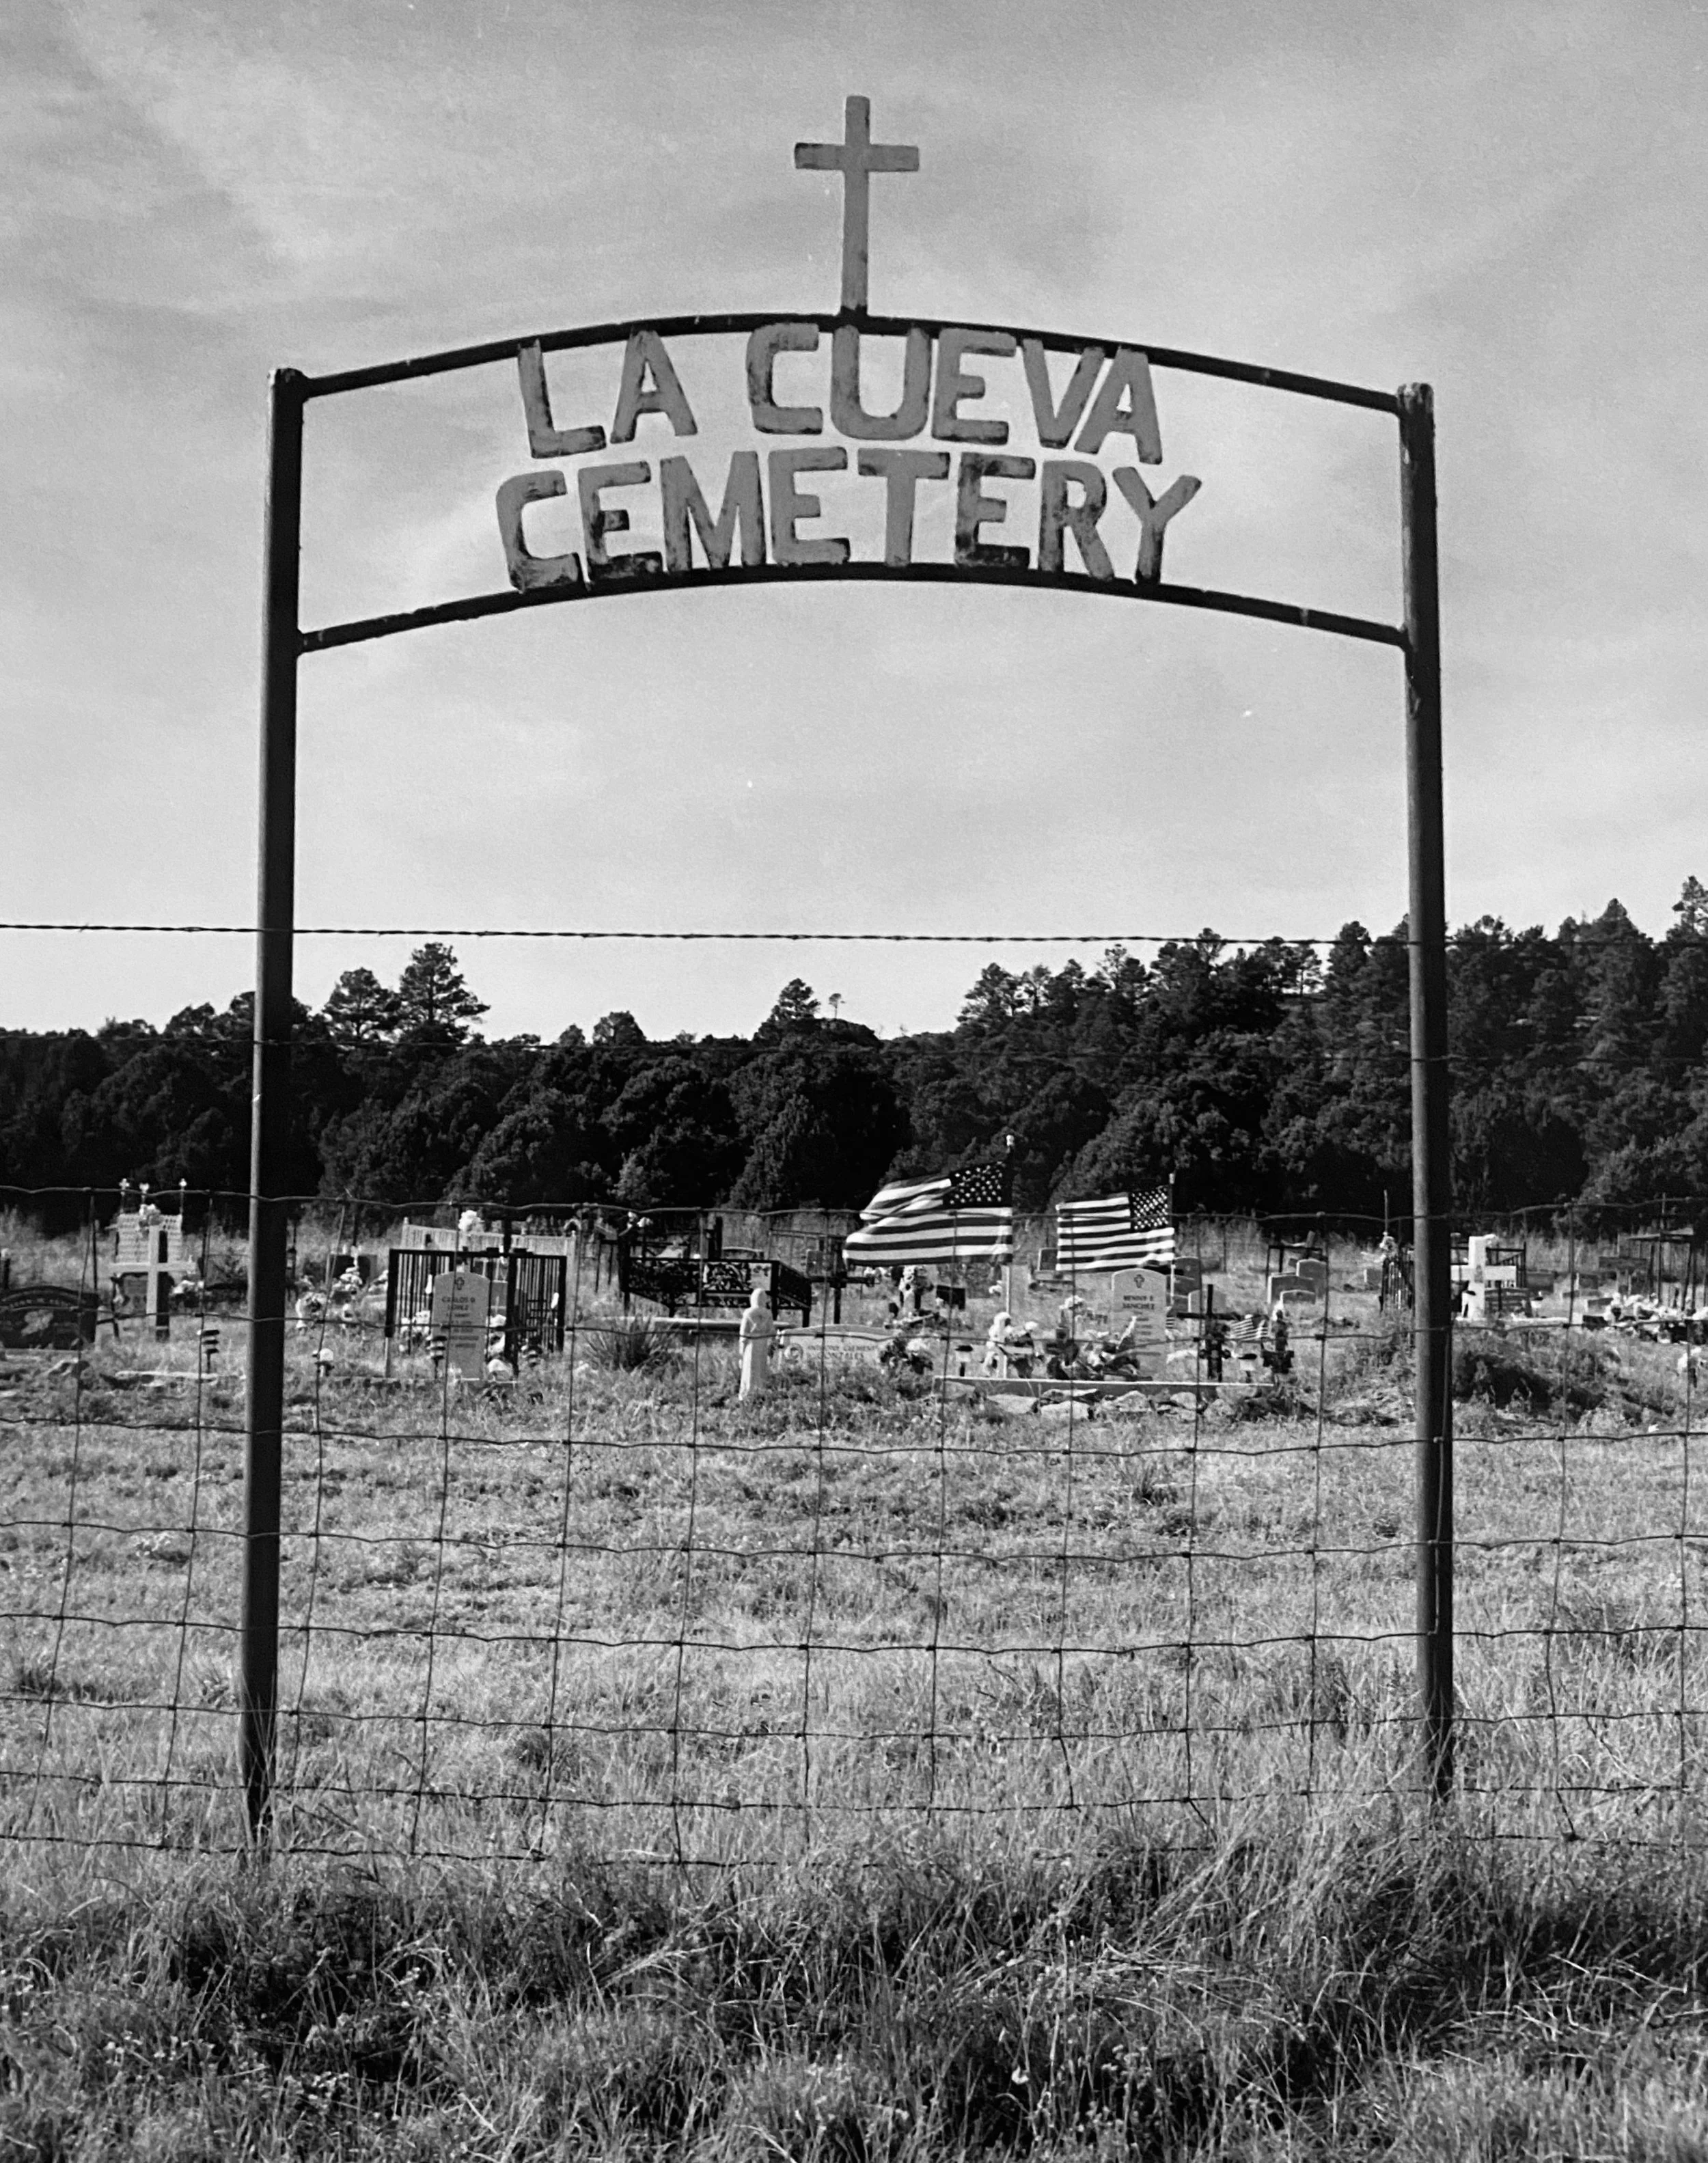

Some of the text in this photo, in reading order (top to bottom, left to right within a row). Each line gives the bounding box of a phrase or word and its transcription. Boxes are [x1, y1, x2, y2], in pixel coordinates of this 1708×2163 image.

[518, 323, 1162, 465] LA CUEVA
[495, 446, 1202, 592] CEMETERY
